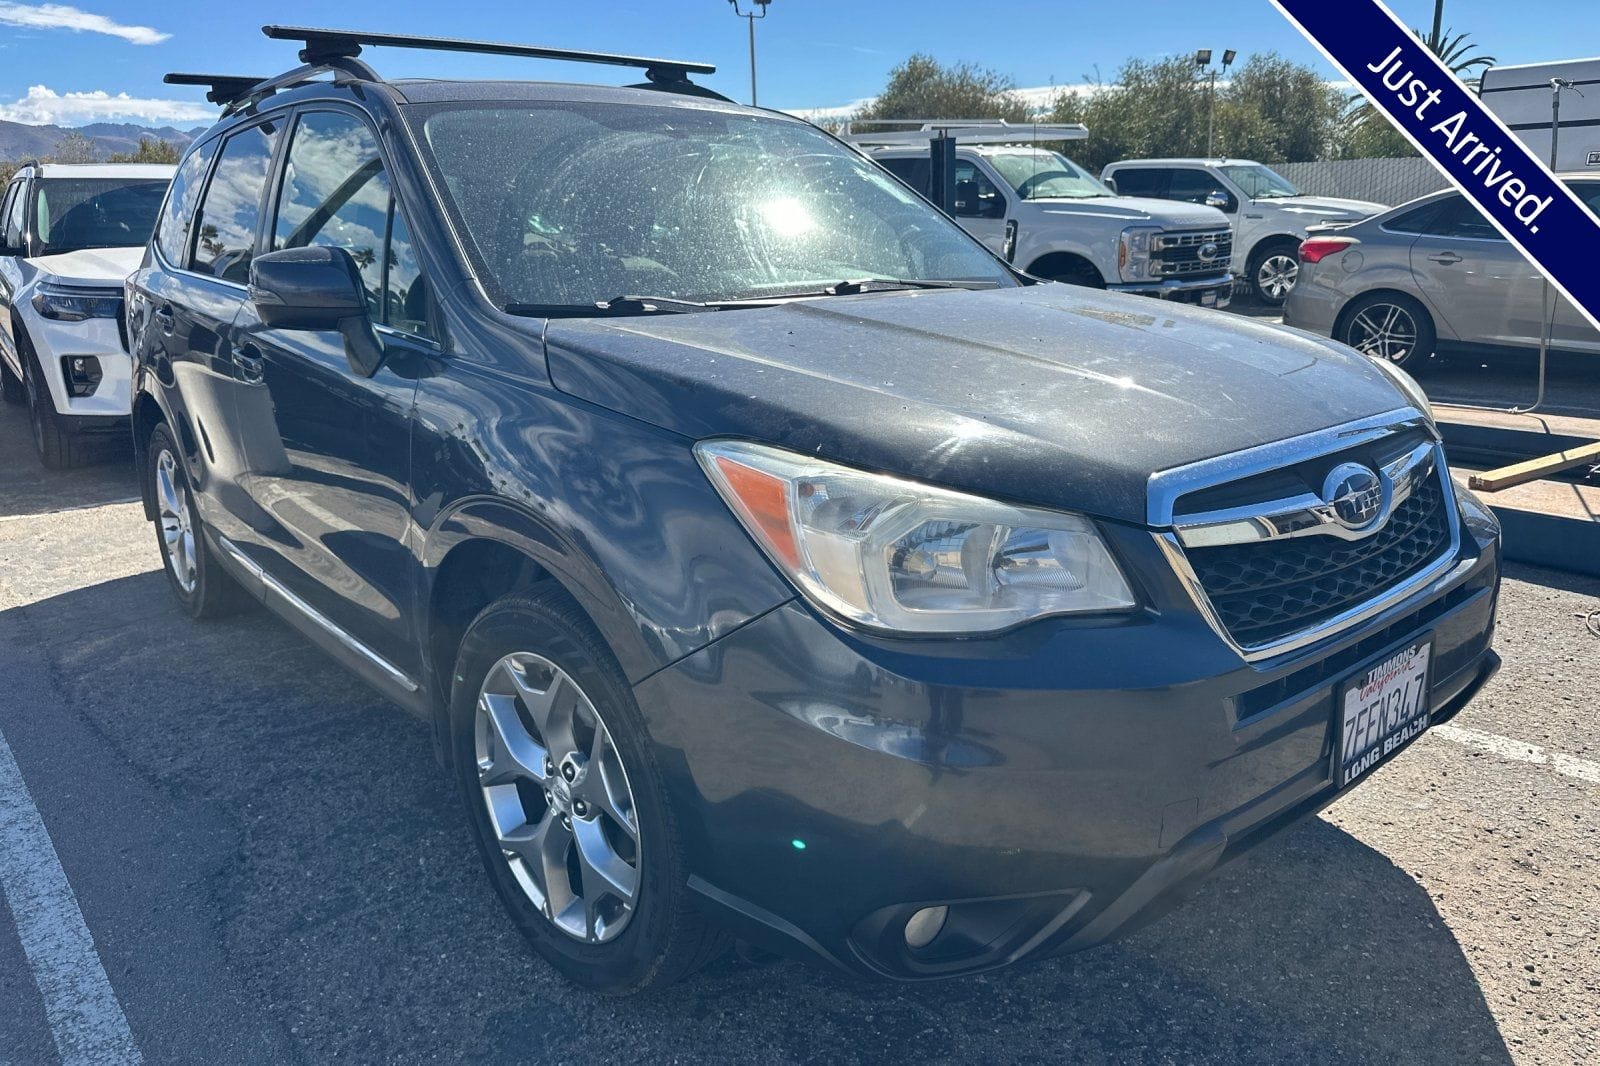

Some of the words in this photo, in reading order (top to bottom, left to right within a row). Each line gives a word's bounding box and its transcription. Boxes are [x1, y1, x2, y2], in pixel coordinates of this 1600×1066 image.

[1367, 645, 1417, 684] TIMMONS
[1344, 747, 1380, 785] LONG
[1383, 714, 1428, 755] BEACH
